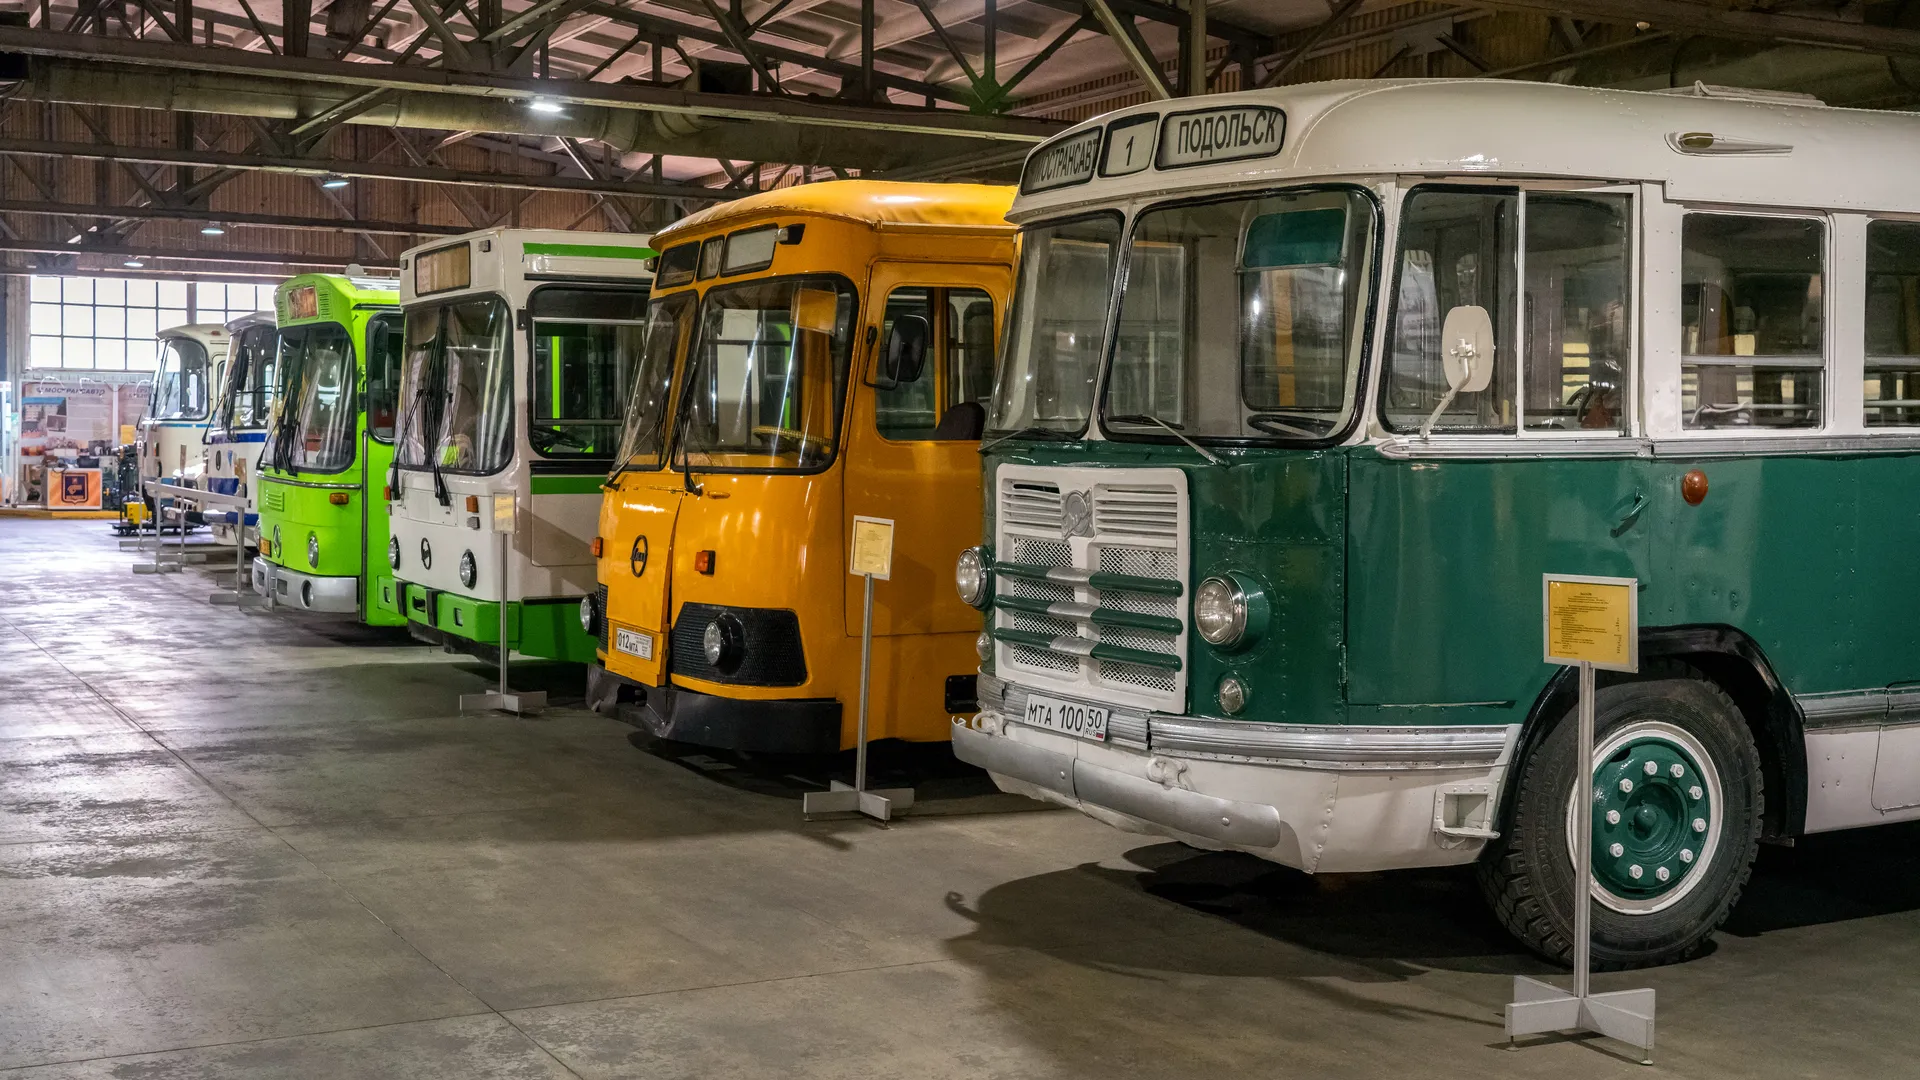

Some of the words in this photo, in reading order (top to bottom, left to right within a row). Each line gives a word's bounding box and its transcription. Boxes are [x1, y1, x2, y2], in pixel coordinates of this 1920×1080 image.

[1177, 109, 1277, 159] ПОДОЛЬСК
[1124, 135, 1135, 167] 1
[1027, 702, 1052, 726] МТА
[1059, 704, 1084, 732] 100
[1087, 708, 1102, 729] 50
[1085, 727, 1097, 737] RUS
